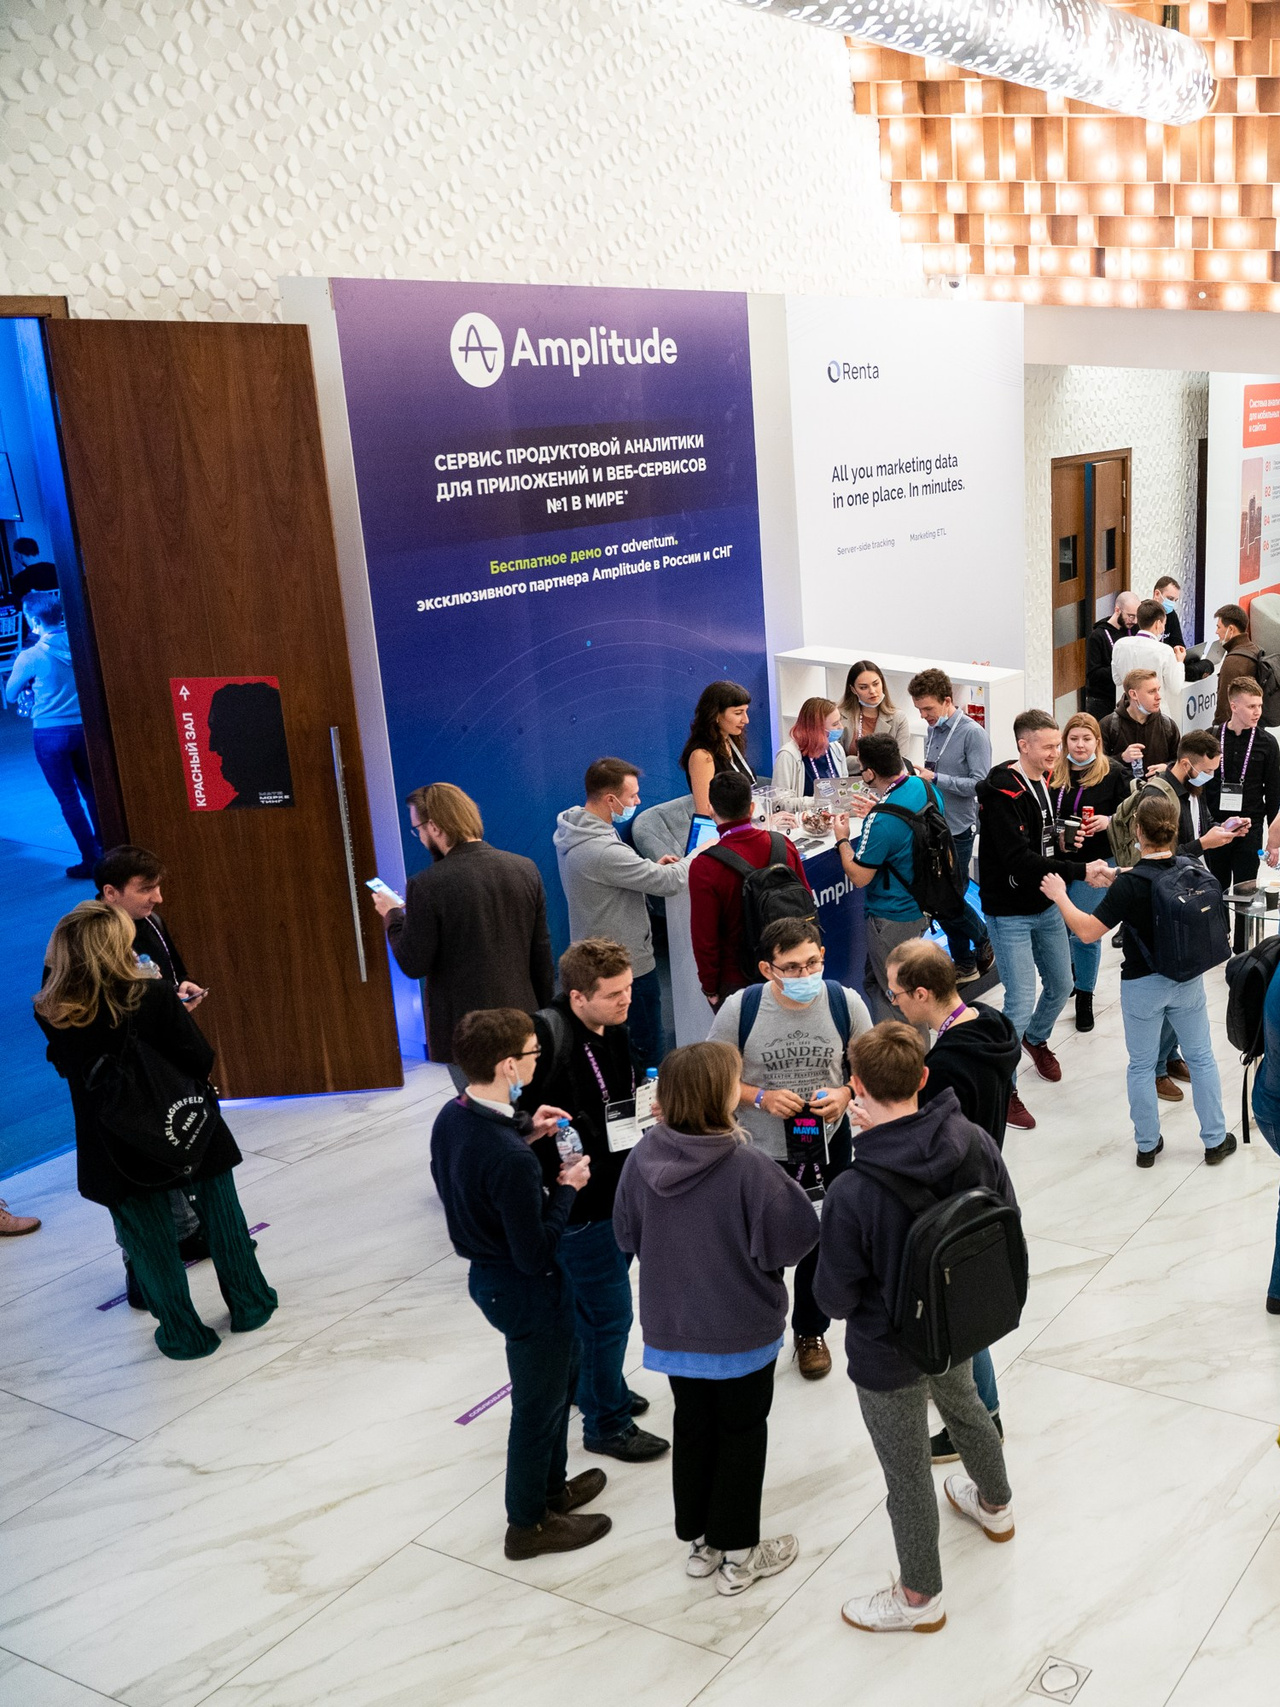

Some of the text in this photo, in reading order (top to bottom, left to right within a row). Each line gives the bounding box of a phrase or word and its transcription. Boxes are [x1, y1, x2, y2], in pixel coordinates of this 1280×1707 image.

[511, 327, 678, 377] Amplitude
[842, 362, 880, 380] Renta
[434, 434, 704, 472] СЕРВИС ПРОДУКТОВОЙ АНАЛИТИКИ
[436, 458, 706, 502] ДЛЯ ПРИЛОЖЕНИЙ И ВЕБ-СЕРВИСОВ
[832, 454, 958, 484] All you marketing data
[546, 496, 568, 514] №1
[571, 496, 582, 510] В
[833, 477, 966, 509] in one place. In minutes.
[837, 537, 896, 556] Server-side tracking
[910, 528, 947, 542] Marketing ETL
[490, 552, 568, 575] Бесплатное
[570, 546, 602, 565] демо
[604, 546, 618, 558] от
[416, 545, 734, 612] эксклюзивного партнера Amplitude в России и СНГ
[1198, 692, 1216, 713] Ren
[182, 712, 207, 806] КРАСНЫЙ ЗАЛ
[812, 874, 854, 908] Ampli
[761, 1046, 834, 1063] DUNDER
[764, 1058, 832, 1072] MIFFLIN
[165, 1096, 204, 1124] LAGERFELD
[182, 1112, 198, 1131] PARIS
[165, 1125, 180, 1146] KARL
[793, 1127, 819, 1135] MAYKI
